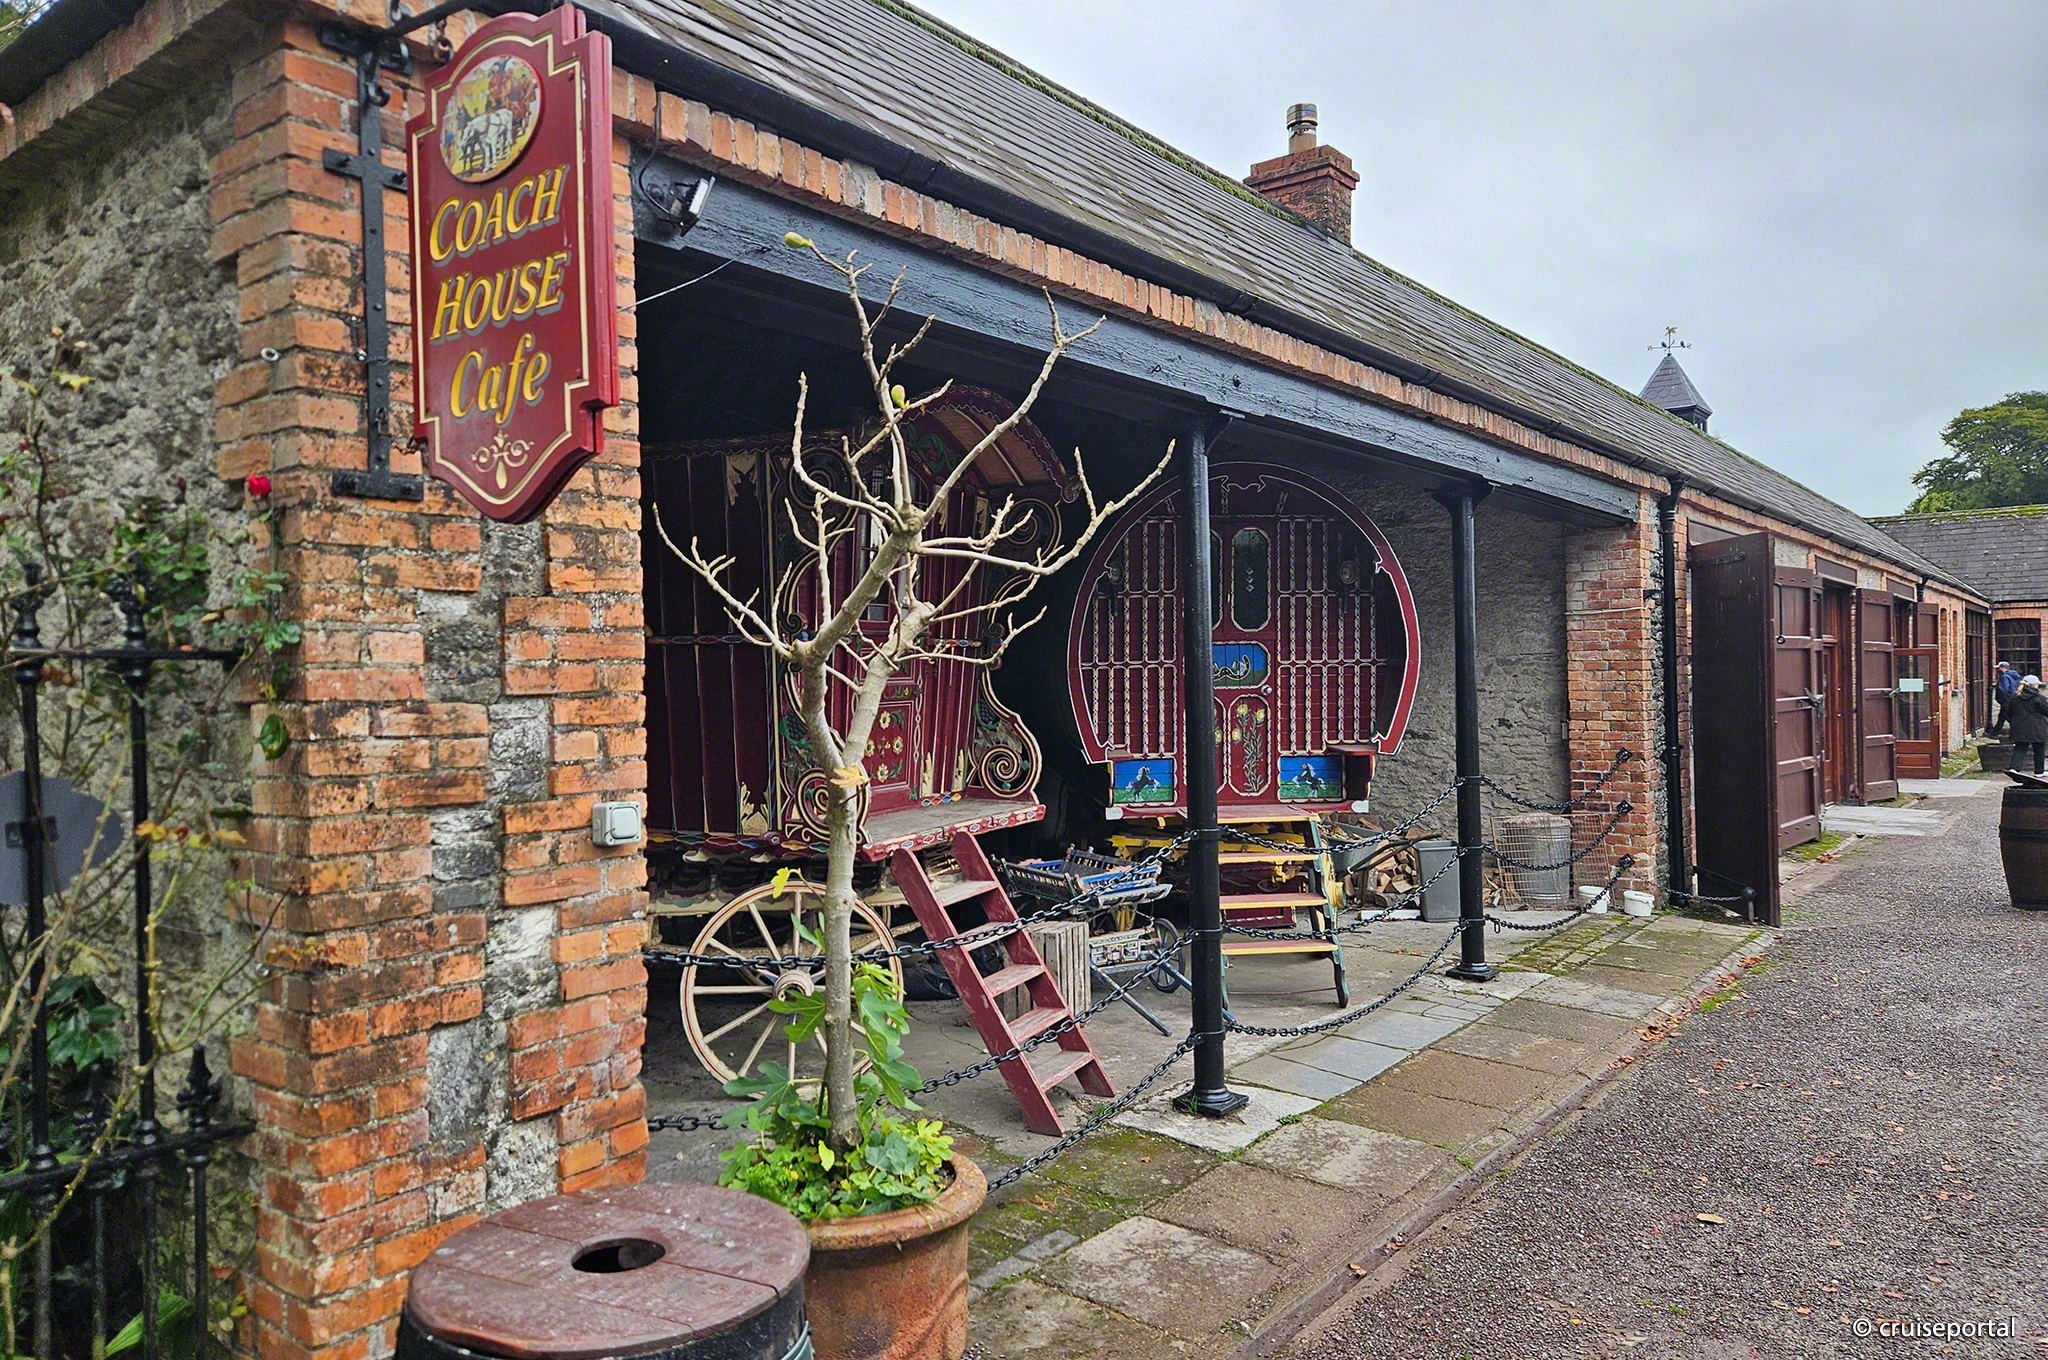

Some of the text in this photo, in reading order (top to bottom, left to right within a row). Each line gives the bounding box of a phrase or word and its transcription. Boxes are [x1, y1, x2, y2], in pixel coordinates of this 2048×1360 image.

[430, 163, 568, 264] COACH
[430, 251, 569, 344] HOUSE
[450, 332, 549, 424] Cafe
